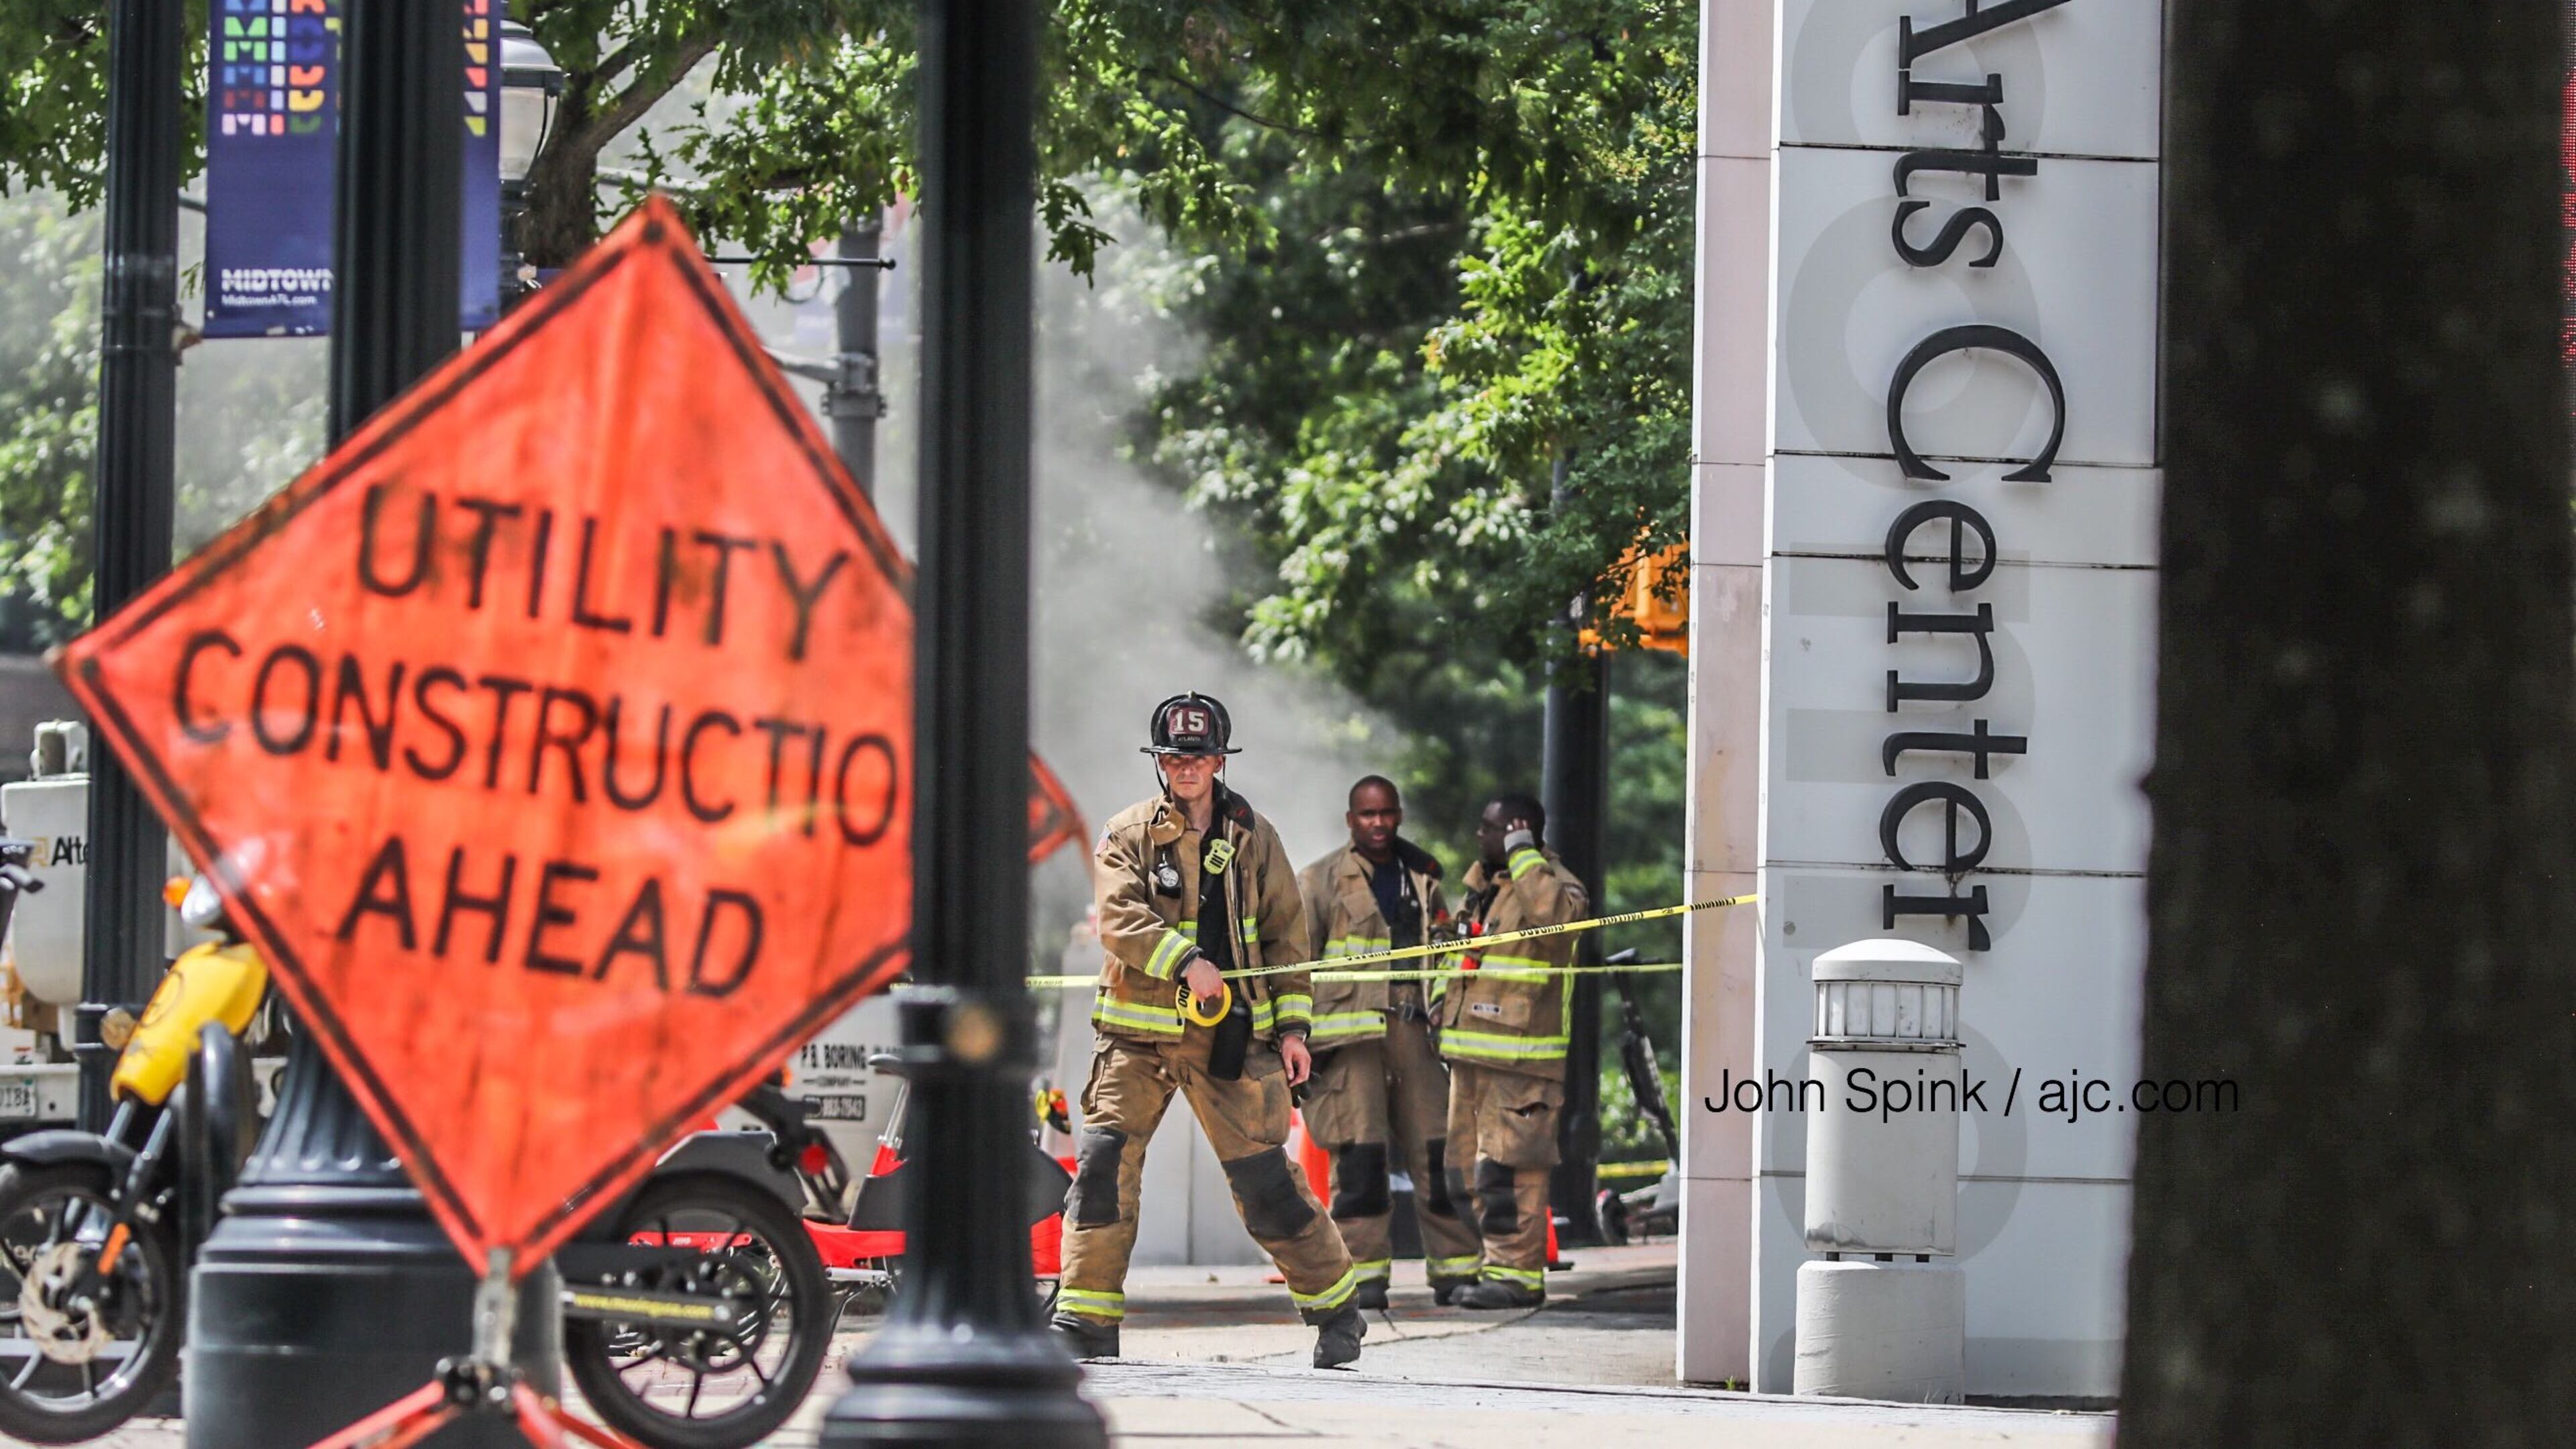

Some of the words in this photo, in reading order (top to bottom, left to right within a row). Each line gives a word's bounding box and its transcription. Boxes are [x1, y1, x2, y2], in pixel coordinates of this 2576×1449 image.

[356, 483, 851, 662] UTILITY
[1879, 325, 2065, 951] Center
[1174, 710, 1204, 732] 15
[337, 836, 765, 998] AHEAD
[824, 1044, 867, 1069] BORING
